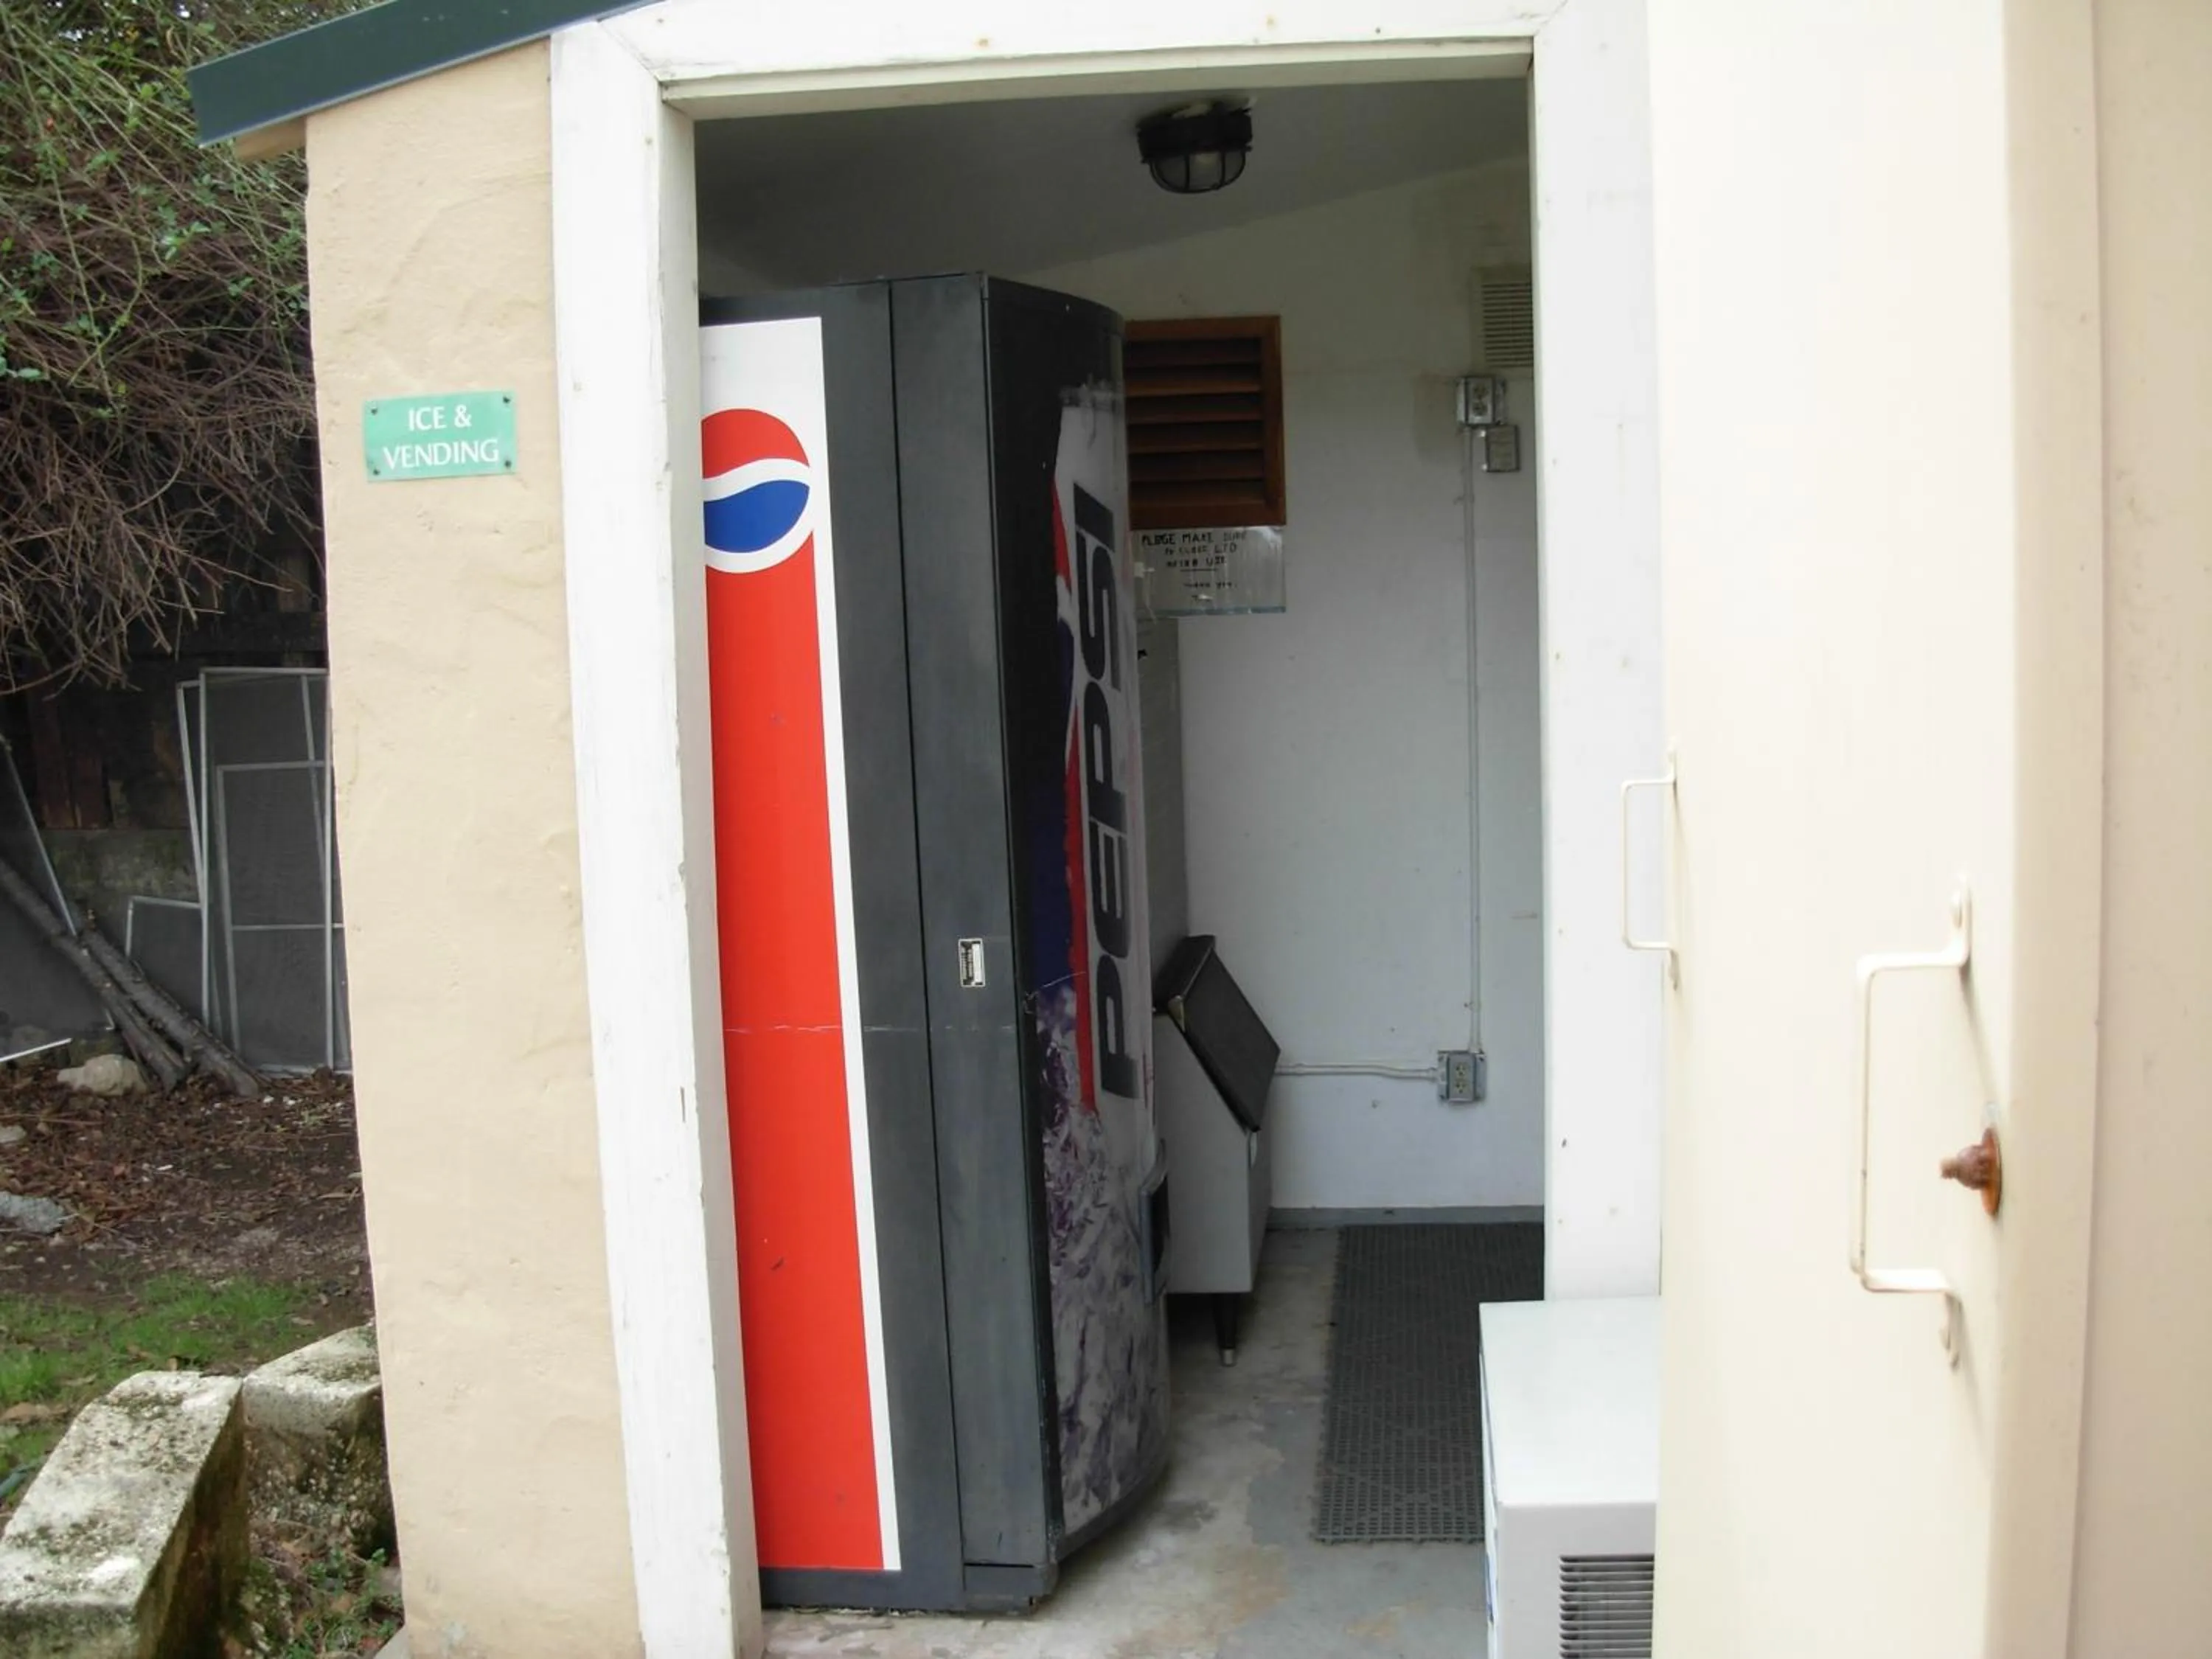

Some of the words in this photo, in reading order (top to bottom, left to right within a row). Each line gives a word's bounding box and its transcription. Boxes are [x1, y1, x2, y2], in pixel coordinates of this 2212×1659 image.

[408, 406, 447, 431] ICE
[453, 403, 472, 428] &
[383, 438, 499, 470] VENDING
[1073, 481, 1138, 1099] PEPSI
